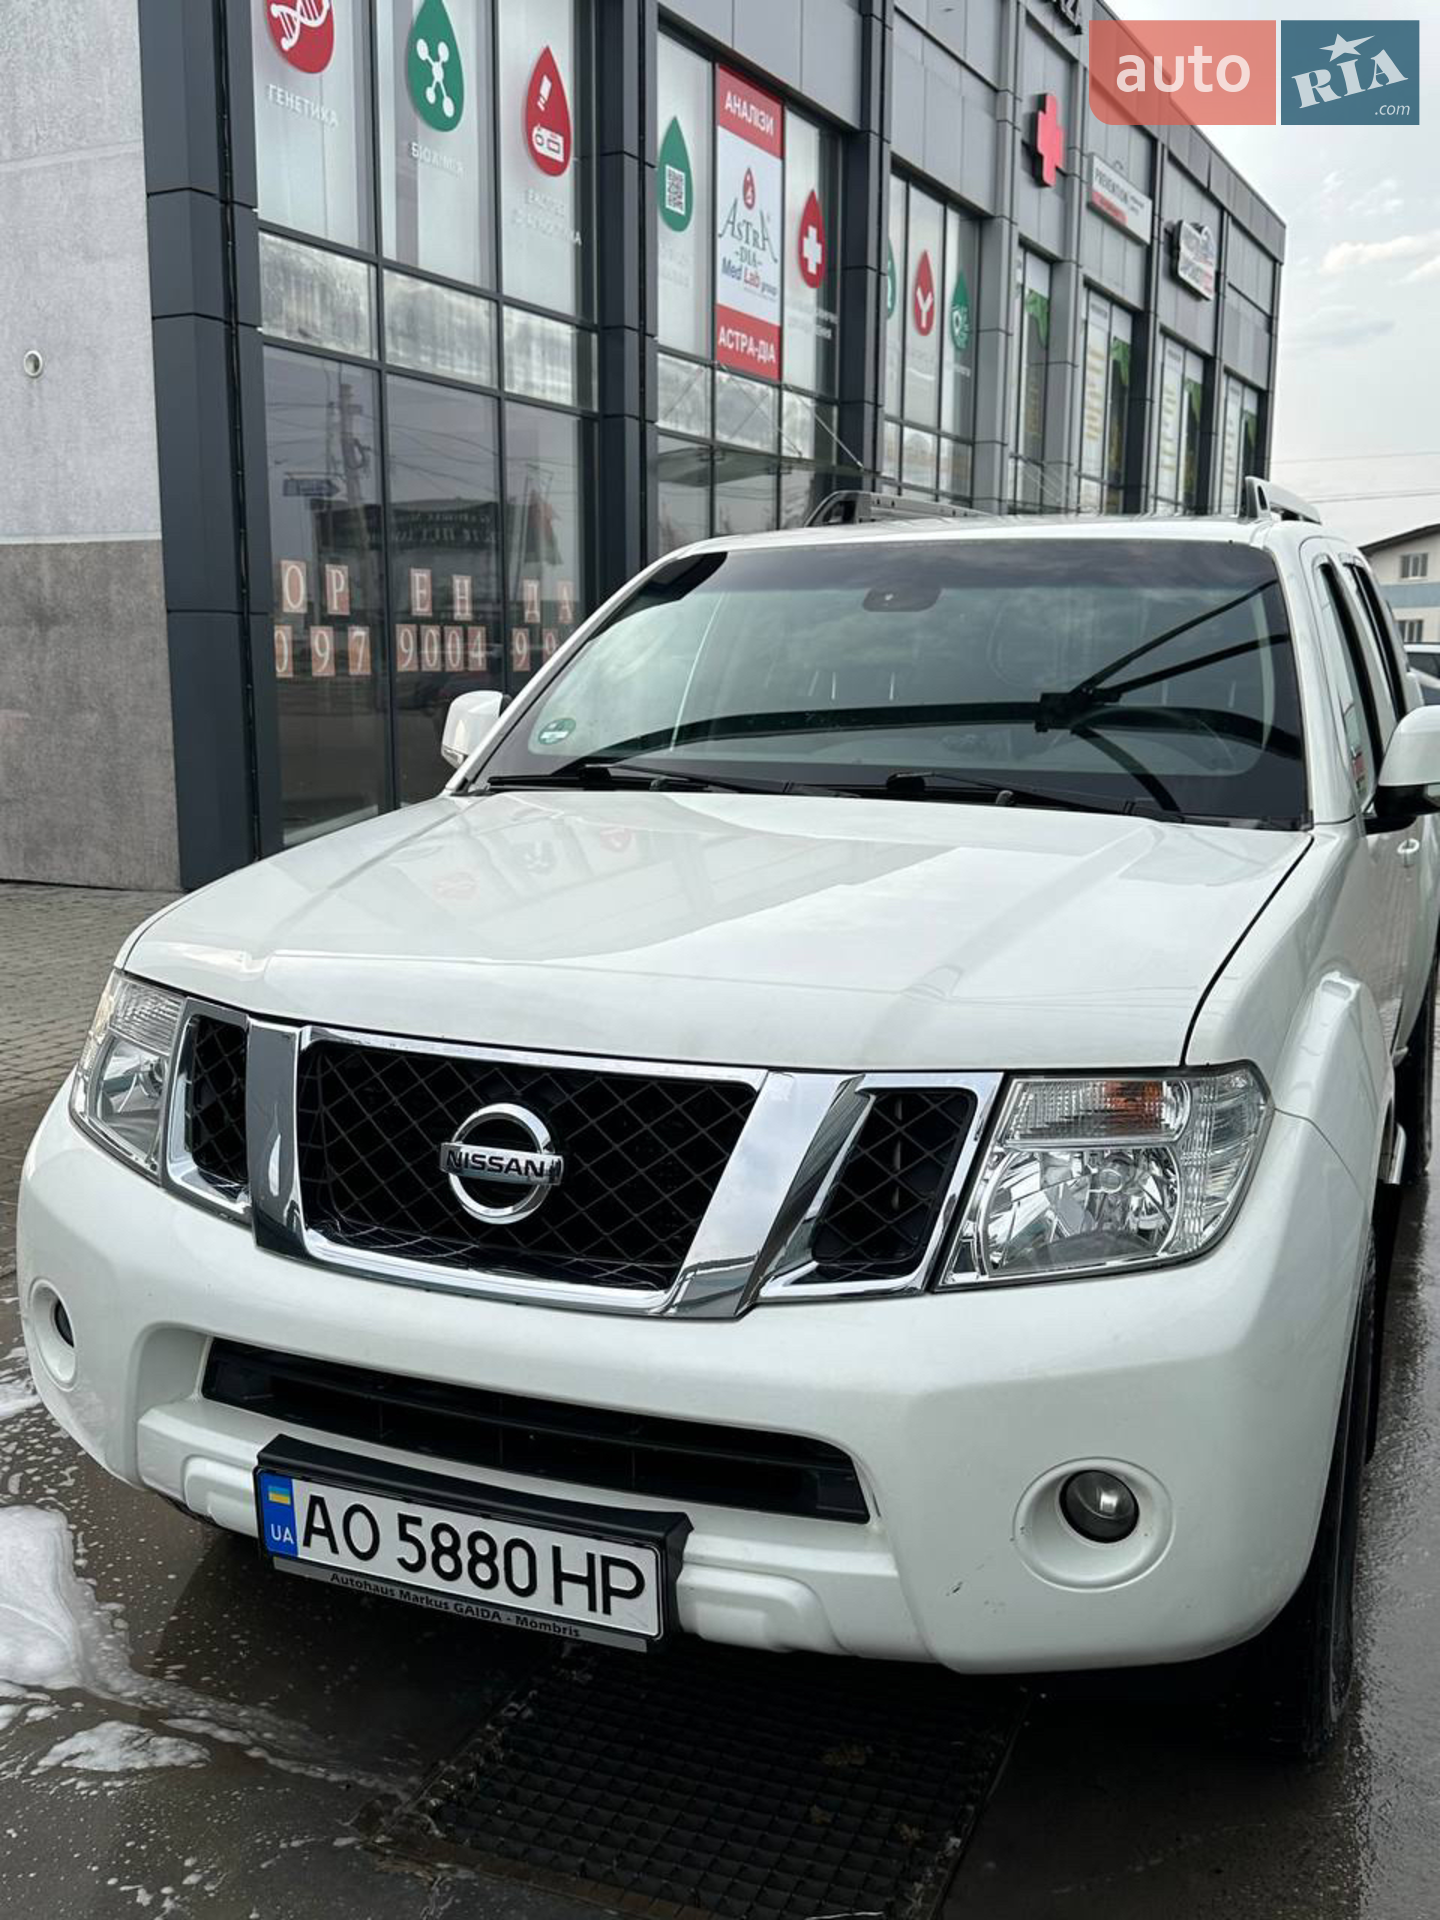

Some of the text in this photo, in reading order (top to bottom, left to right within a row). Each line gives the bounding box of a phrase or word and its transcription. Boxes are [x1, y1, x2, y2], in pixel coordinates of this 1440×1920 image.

[269, 84, 339, 129] ГЕНЕТИКА
[725, 91, 774, 136] АНАЛІЗИ
[446, 1149, 545, 1178] NISSAN
[270, 1522, 295, 1546] UA
[303, 1494, 646, 1615] AO 5880 HP
[330, 1571, 396, 1598] Autohaus
[398, 1588, 451, 1612] Markus
[453, 1601, 502, 1623] GAIDA
